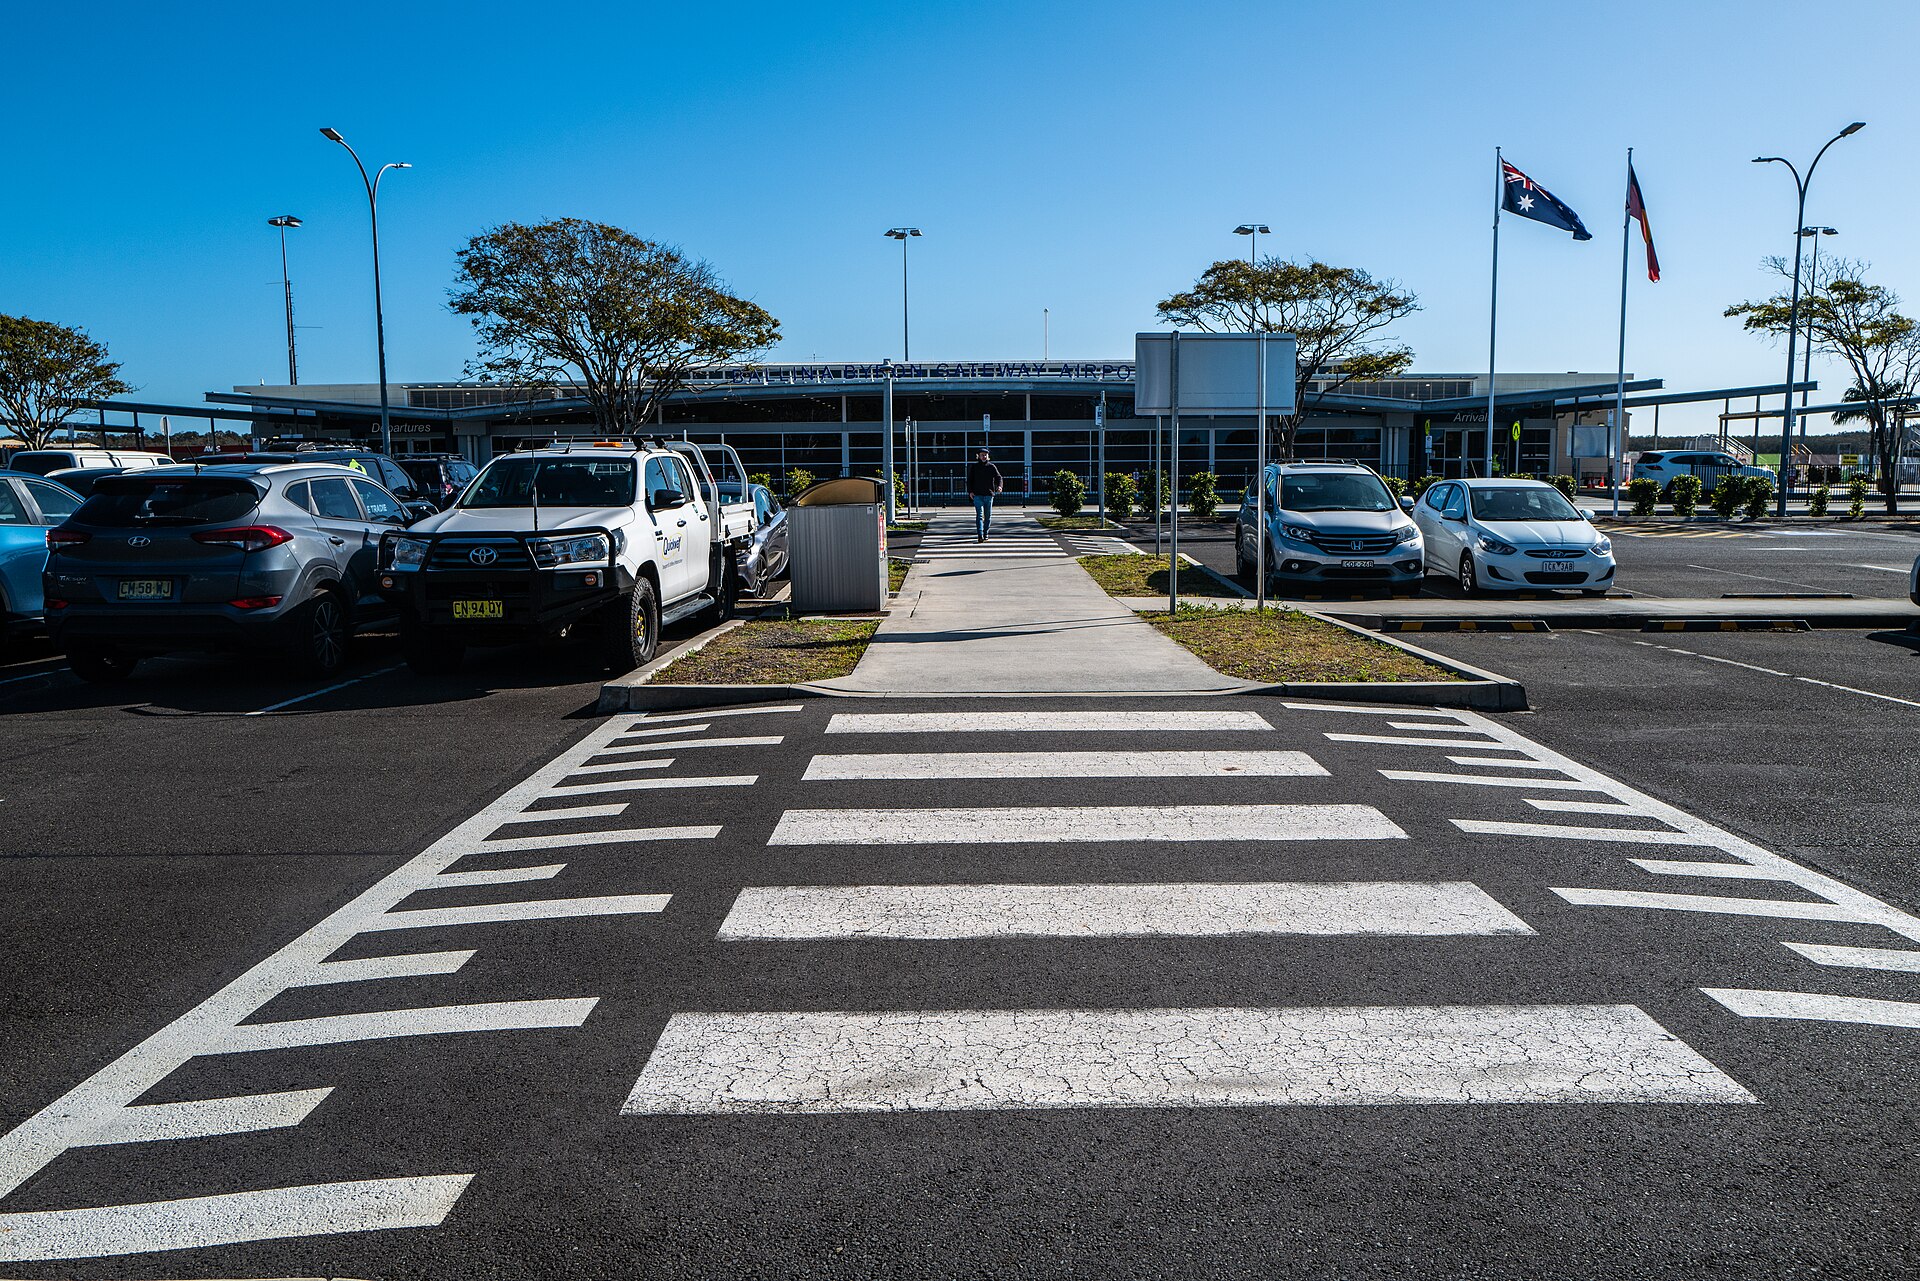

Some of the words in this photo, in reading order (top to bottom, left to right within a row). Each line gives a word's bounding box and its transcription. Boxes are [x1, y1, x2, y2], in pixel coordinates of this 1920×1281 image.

[732, 365, 834, 384] BALLINA
[844, 363, 922, 380] BYRON
[936, 362, 1046, 378] GATEWAY
[1059, 363, 1131, 380] AIRPO
[1453, 412, 1490, 422] Arrival
[203, 445, 222, 453] AVS
